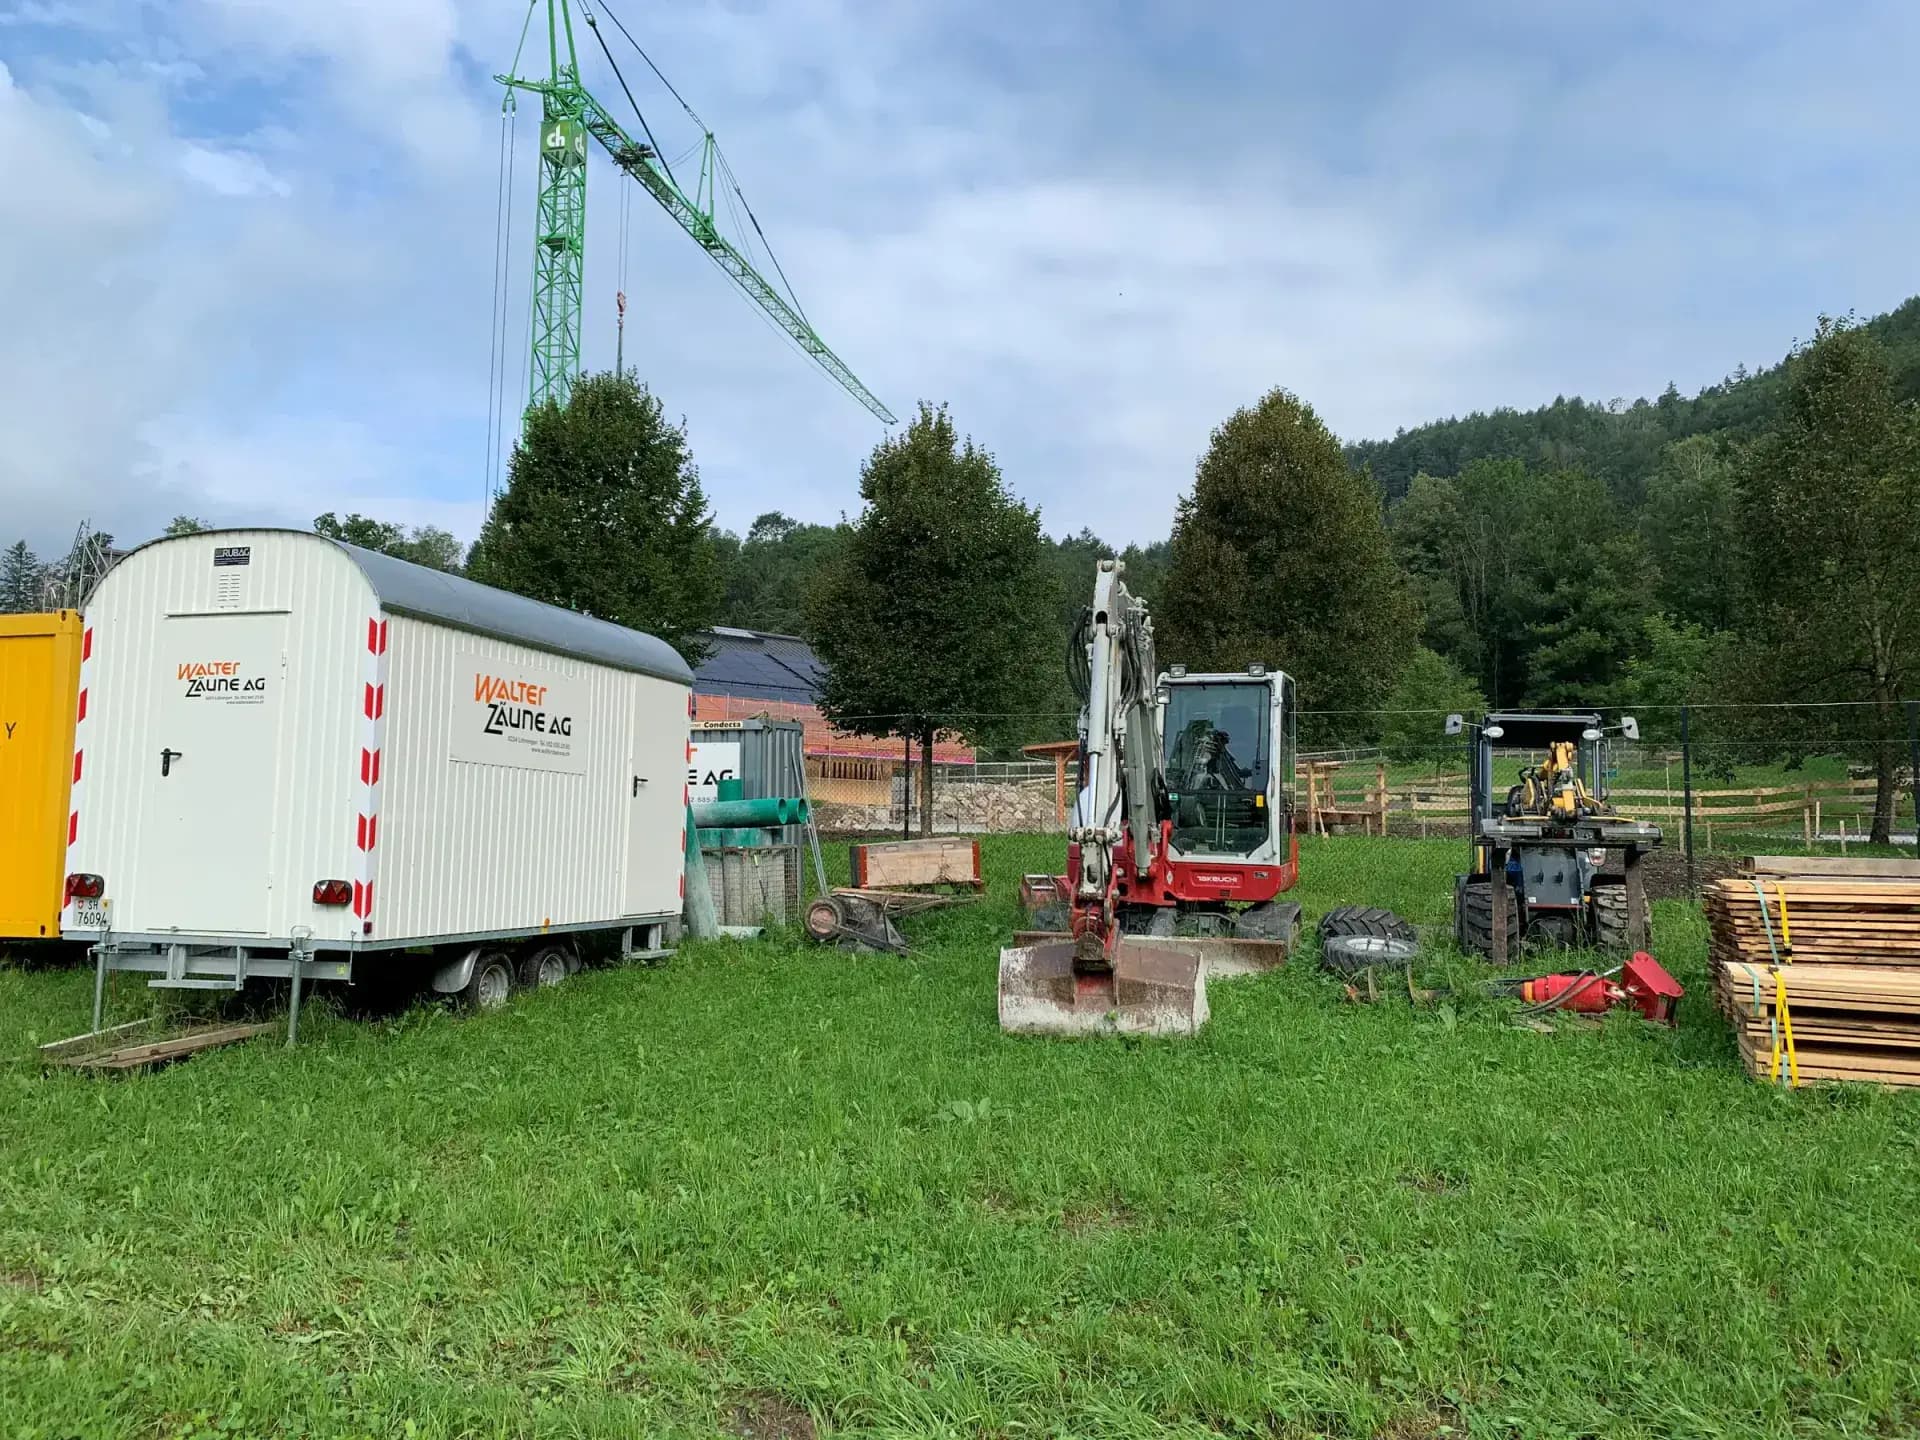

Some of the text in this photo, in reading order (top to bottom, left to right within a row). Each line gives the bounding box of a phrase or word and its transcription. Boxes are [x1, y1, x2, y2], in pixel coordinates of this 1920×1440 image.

[243, 678, 265, 691] AG
[549, 715, 571, 736] AG
[703, 721, 741, 729] Condecta
